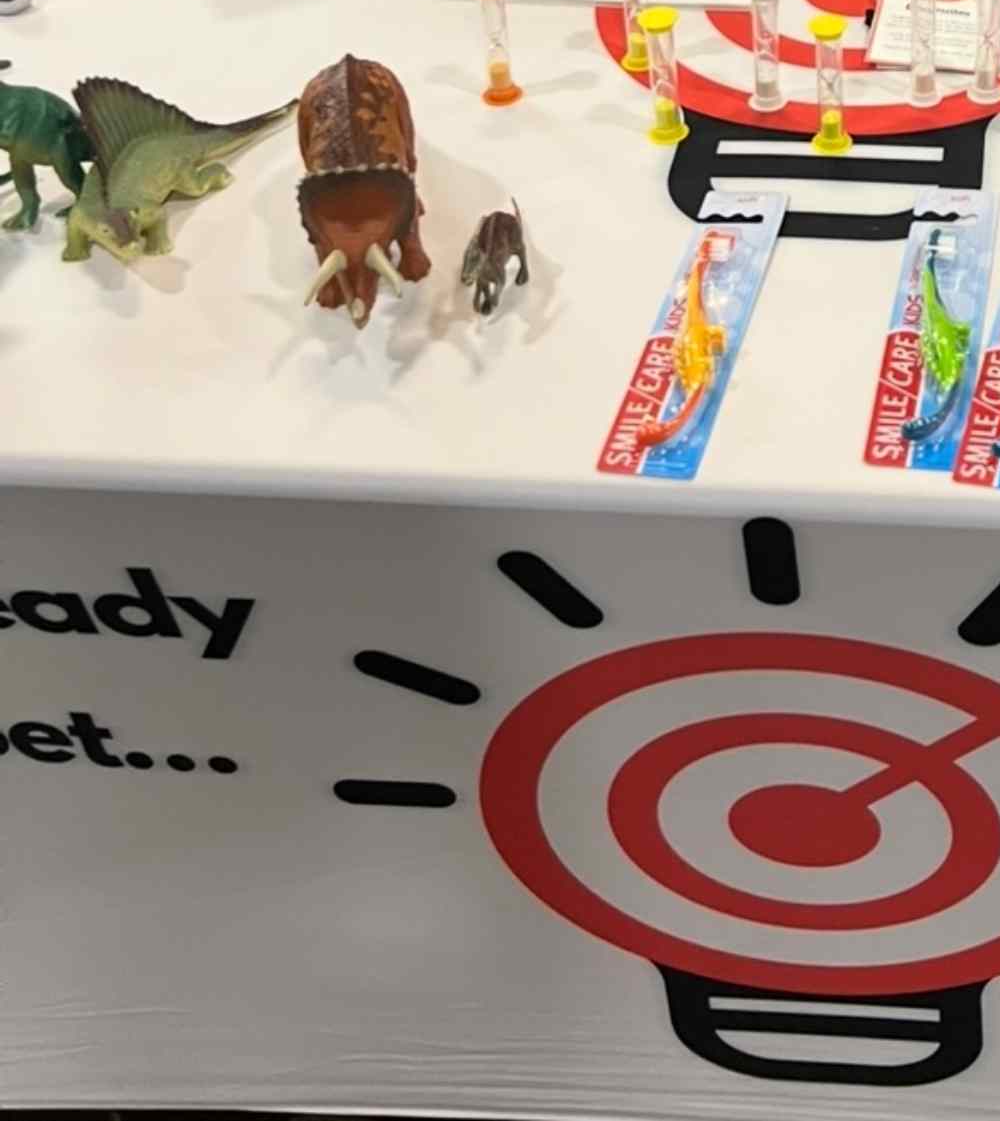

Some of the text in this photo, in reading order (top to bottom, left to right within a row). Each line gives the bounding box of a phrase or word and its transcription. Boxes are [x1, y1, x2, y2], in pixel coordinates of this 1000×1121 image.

[664, 296, 687, 331] KIDS
[902, 295, 923, 328] KIDS
[0, 567, 256, 660] ady
